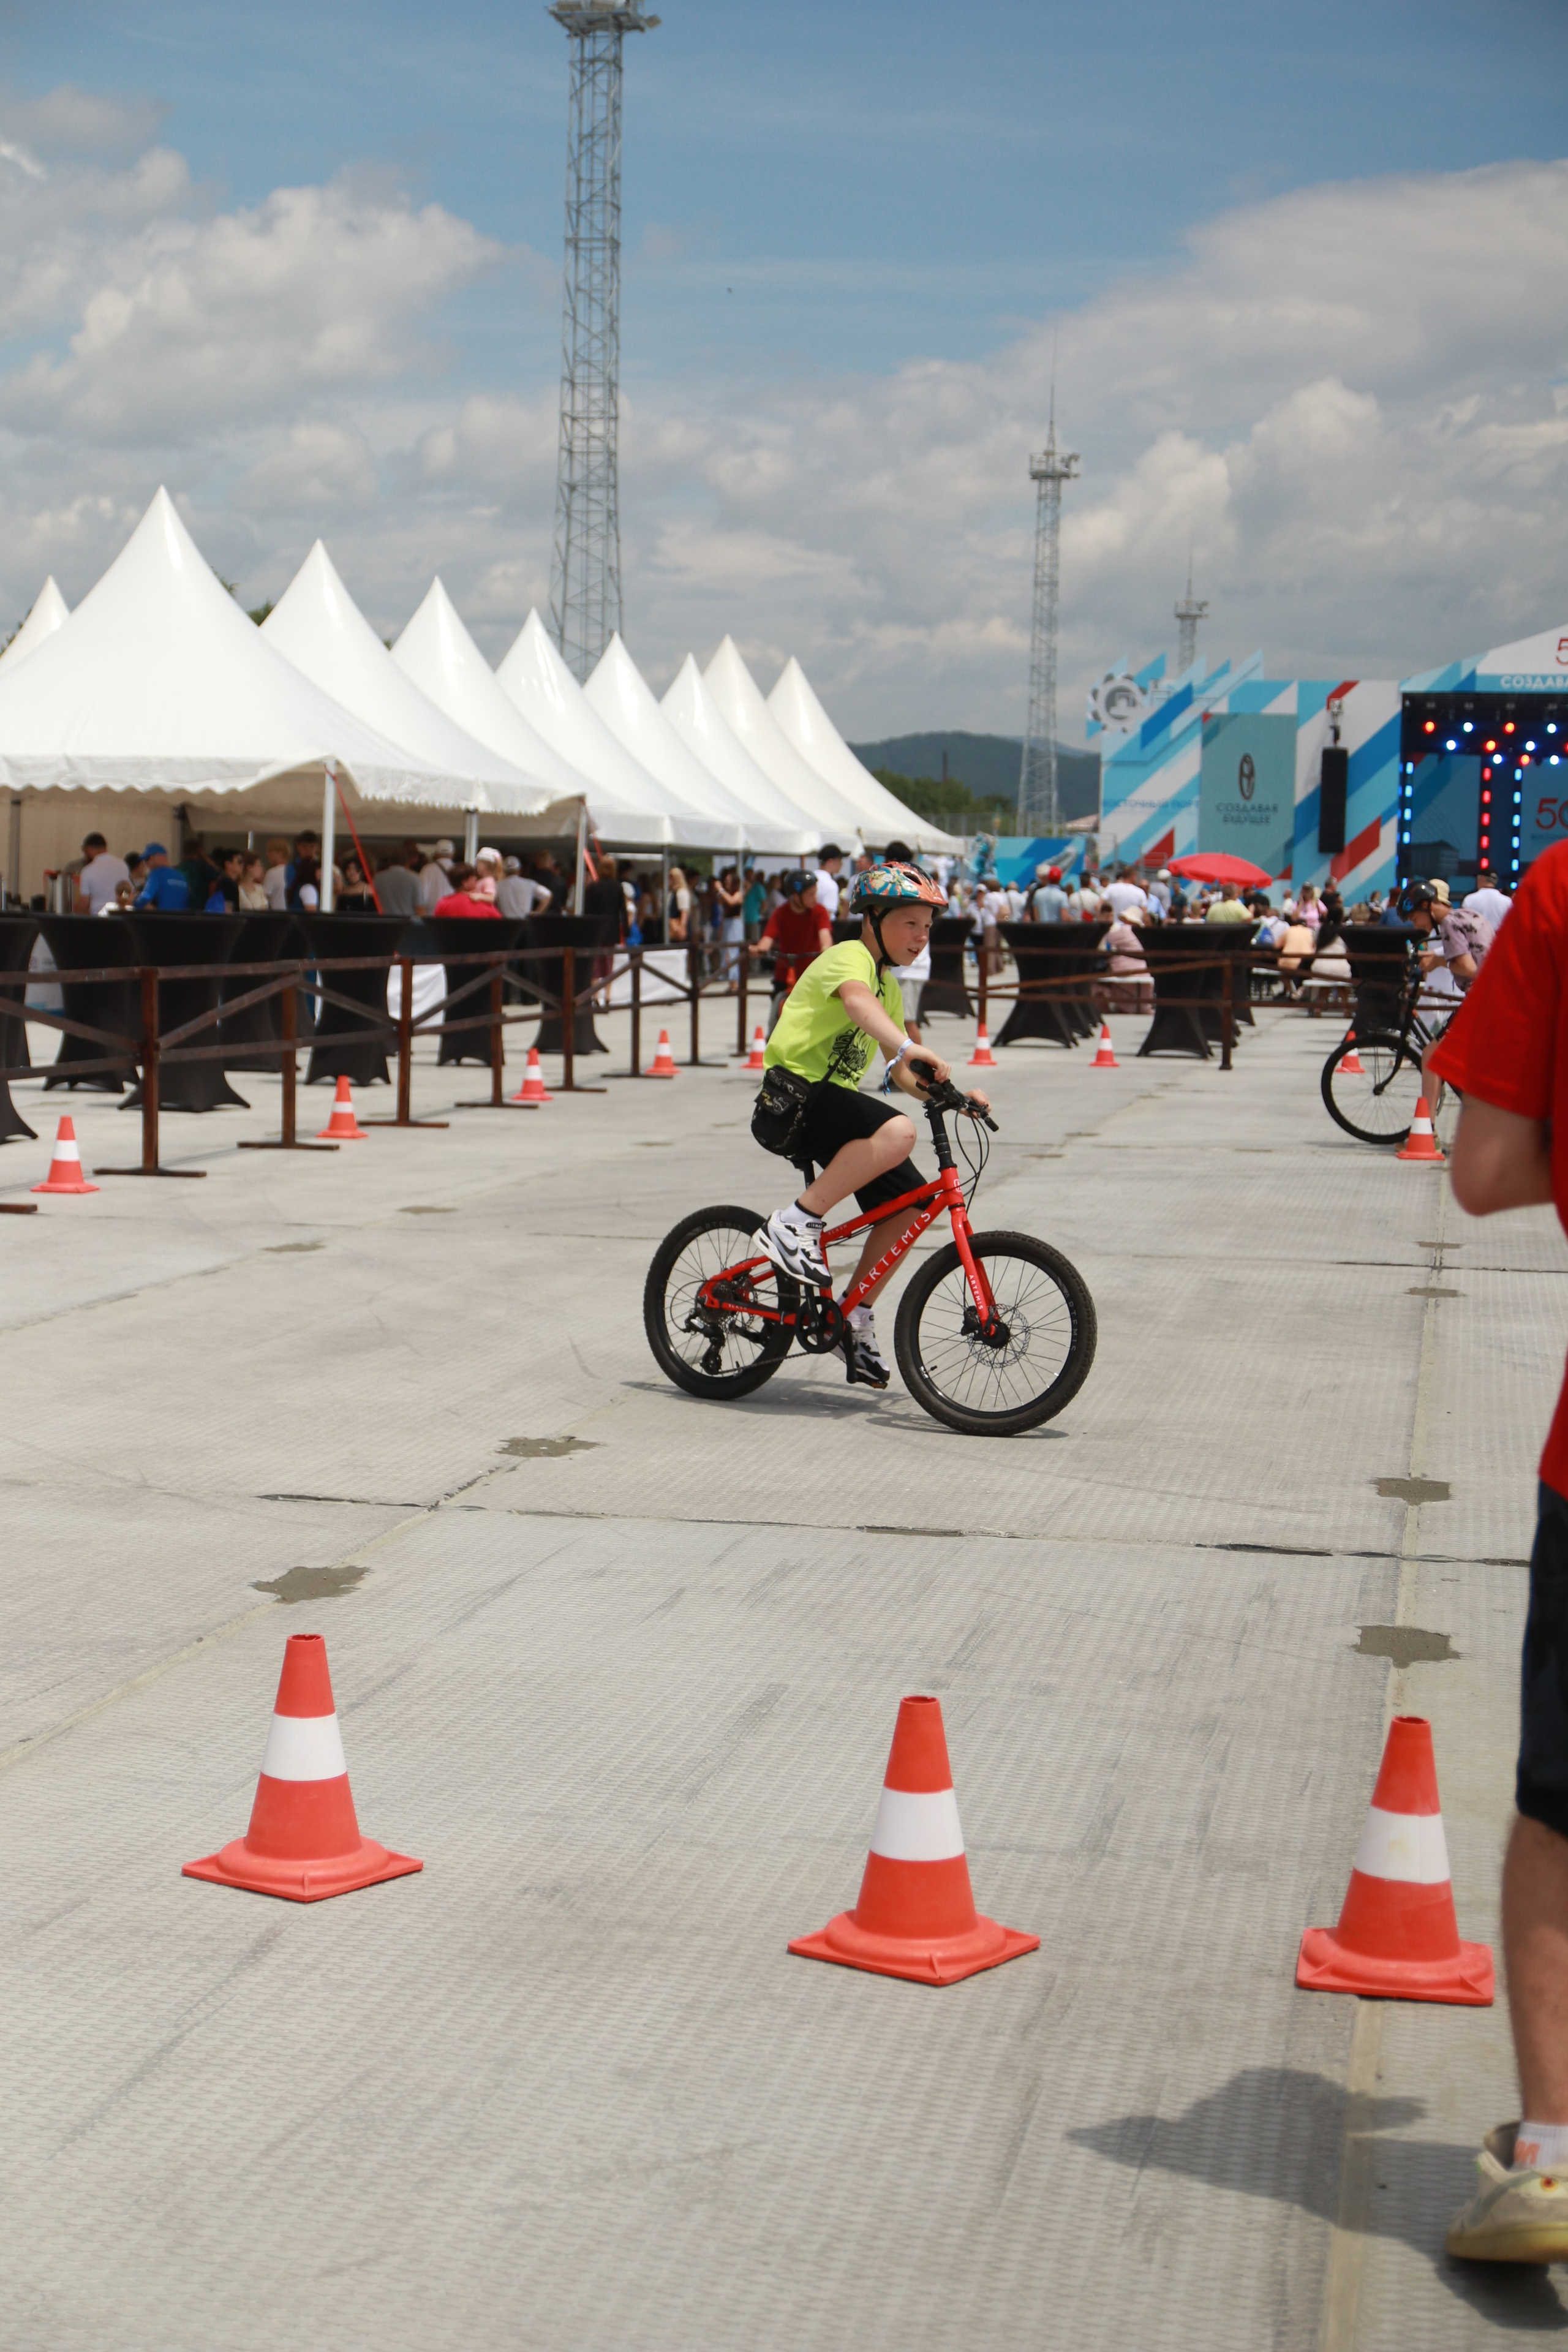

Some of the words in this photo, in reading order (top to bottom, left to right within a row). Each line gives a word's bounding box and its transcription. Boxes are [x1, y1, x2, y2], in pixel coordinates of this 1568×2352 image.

[1500, 675, 1568, 688] СОЗДАВ
[1216, 803, 1278, 813] СОЗДАВАЯ
[828, 1224, 847, 1235] SLASH
[859, 1213, 931, 1294] ARTEMIS
[969, 1275, 983, 1310] ARTEMIS
[1064, 1292, 1078, 1351] ARTEMIS
